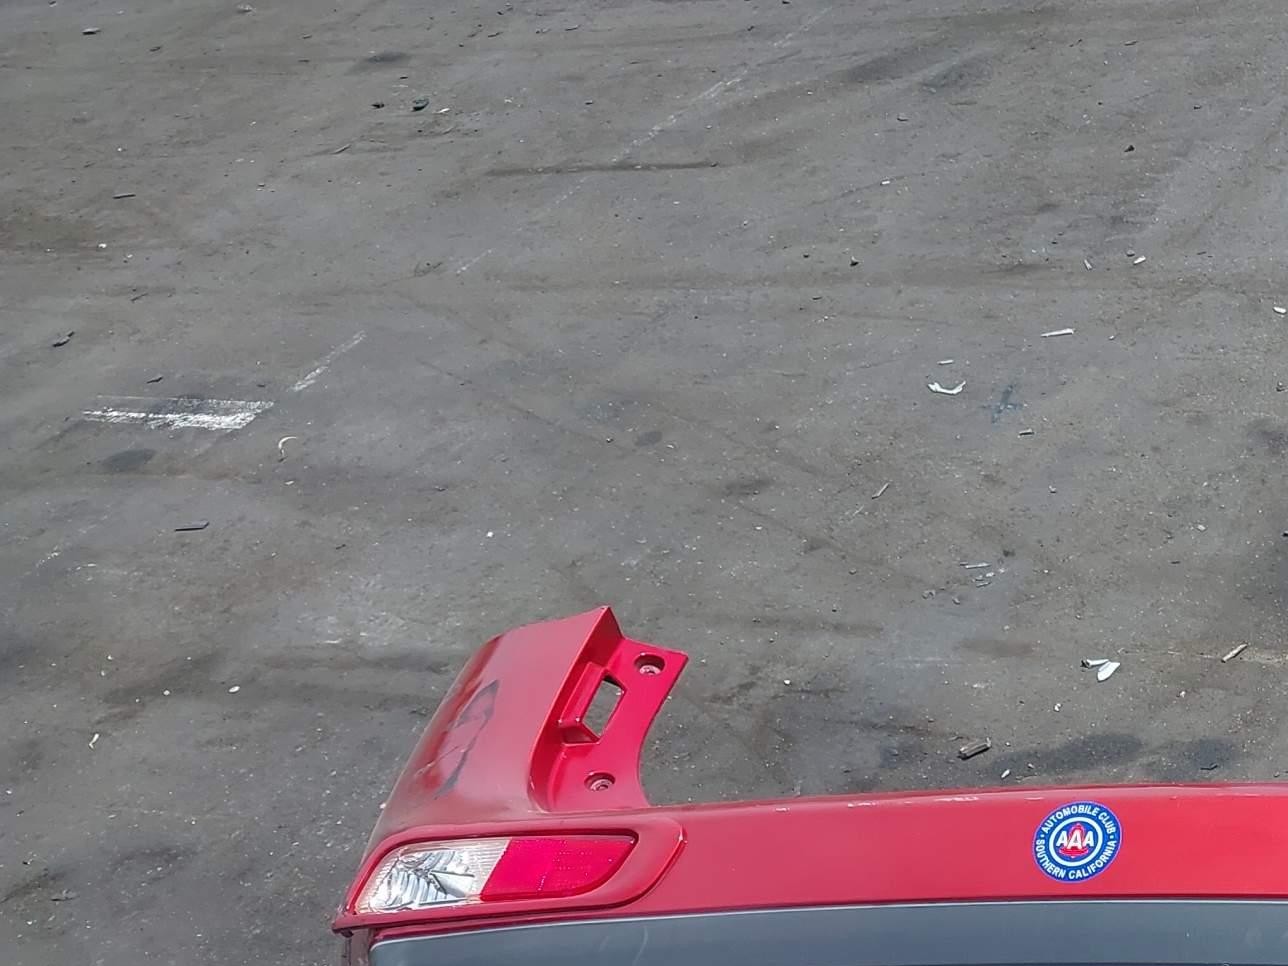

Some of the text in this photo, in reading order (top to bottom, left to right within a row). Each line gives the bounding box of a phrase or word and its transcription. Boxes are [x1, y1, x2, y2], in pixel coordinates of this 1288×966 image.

[1041, 804, 1117, 834] AUTOMOBILE CLUB
[1056, 829, 1095, 850] AAA
[1035, 839, 1117, 880] SOUTHERN CALIFORNIA
